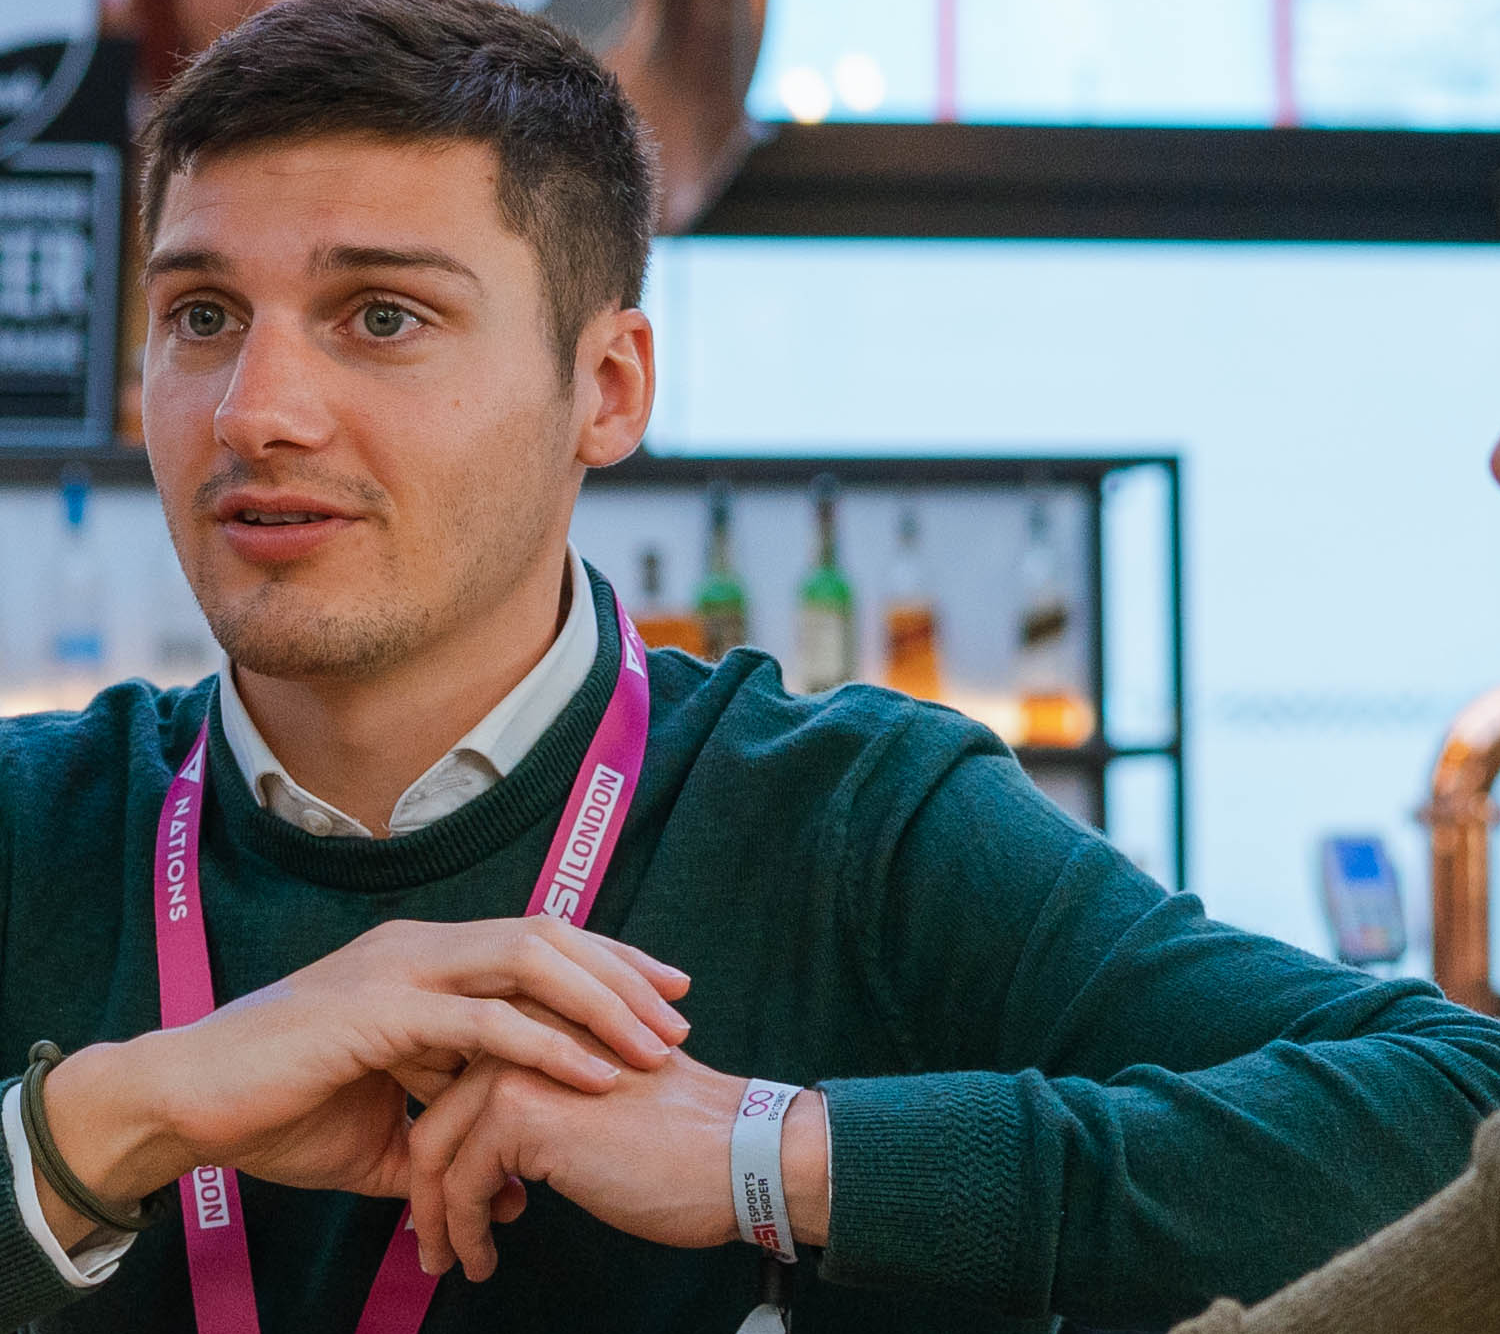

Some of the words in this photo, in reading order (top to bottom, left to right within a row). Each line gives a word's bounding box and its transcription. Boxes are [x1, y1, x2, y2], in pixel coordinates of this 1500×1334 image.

[569, 771, 618, 870] LONDON
[167, 795, 191, 922] NATIONS
[744, 1172, 761, 1223] ESPORTS
[758, 1178, 774, 1222] INSIDER
